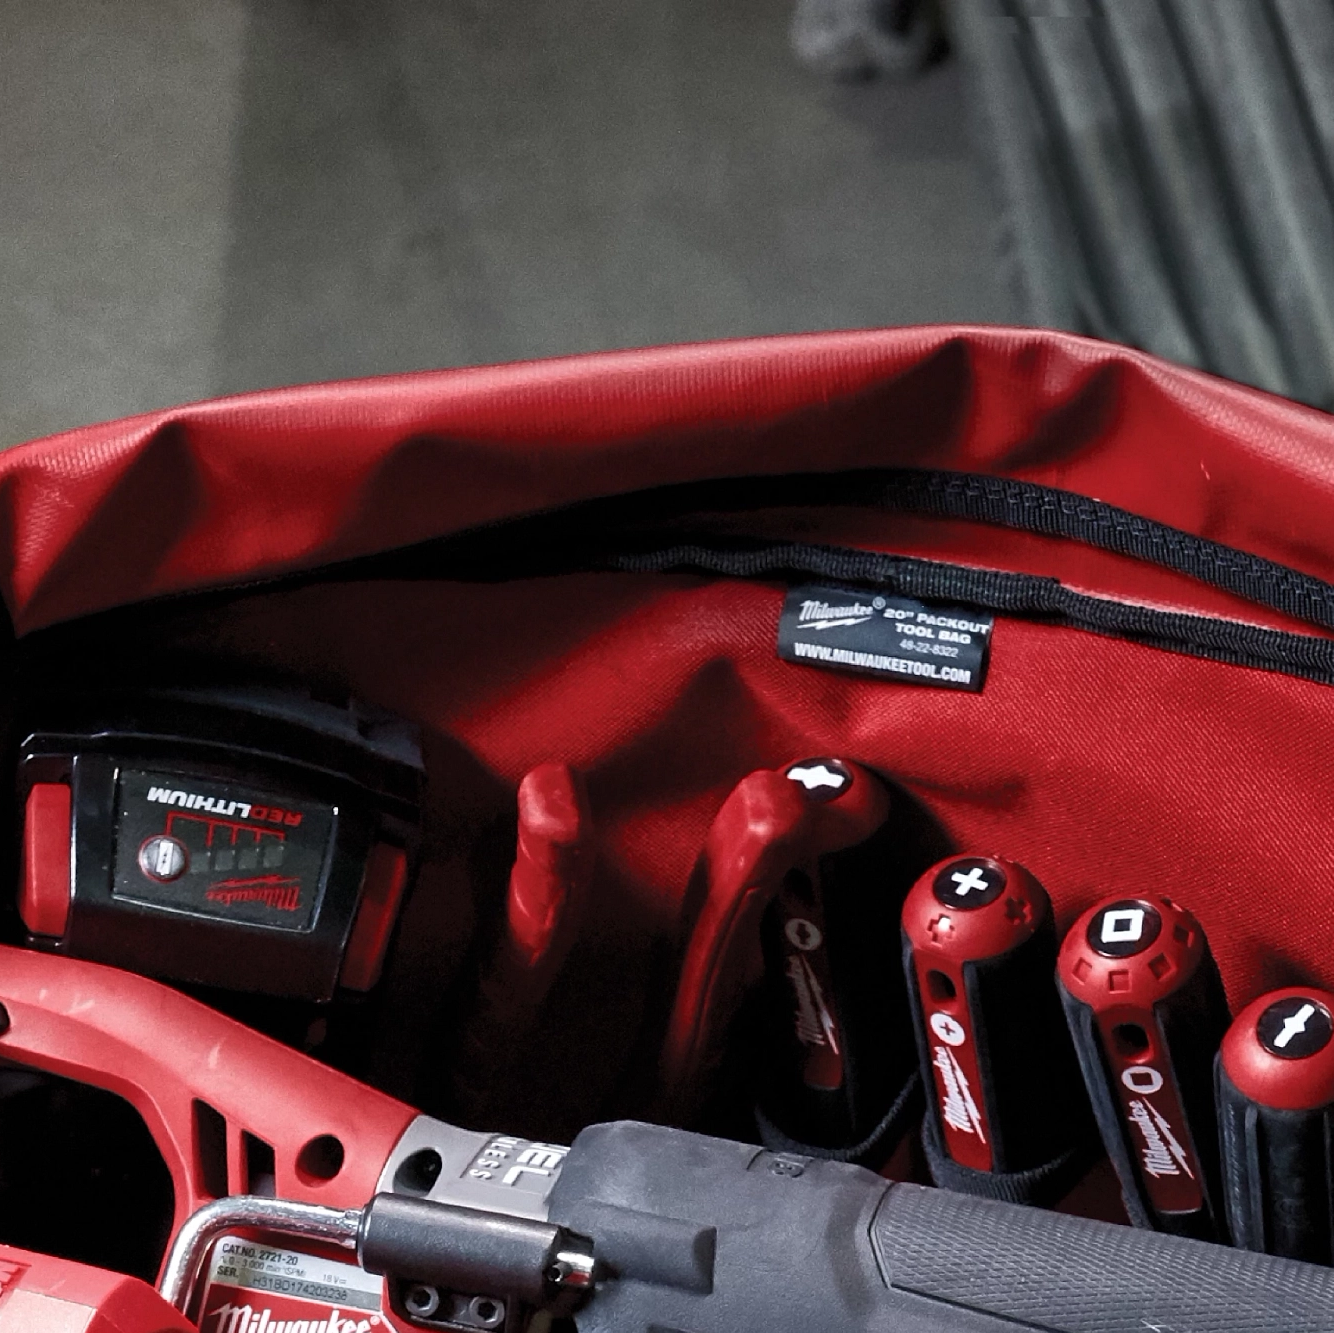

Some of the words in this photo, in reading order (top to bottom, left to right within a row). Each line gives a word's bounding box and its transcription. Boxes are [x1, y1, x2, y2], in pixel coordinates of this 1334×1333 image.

[799, 600, 873, 621] Milwaukee
[894, 622, 936, 639] TOOL
[938, 630, 971, 645] BAG
[916, 613, 991, 635] PACKOUT
[794, 642, 971, 684] WWW.MILWAUKEETOOL.COM
[258, 1250, 299, 1266] 2721-20
[216, 1265, 239, 1279] SER.
